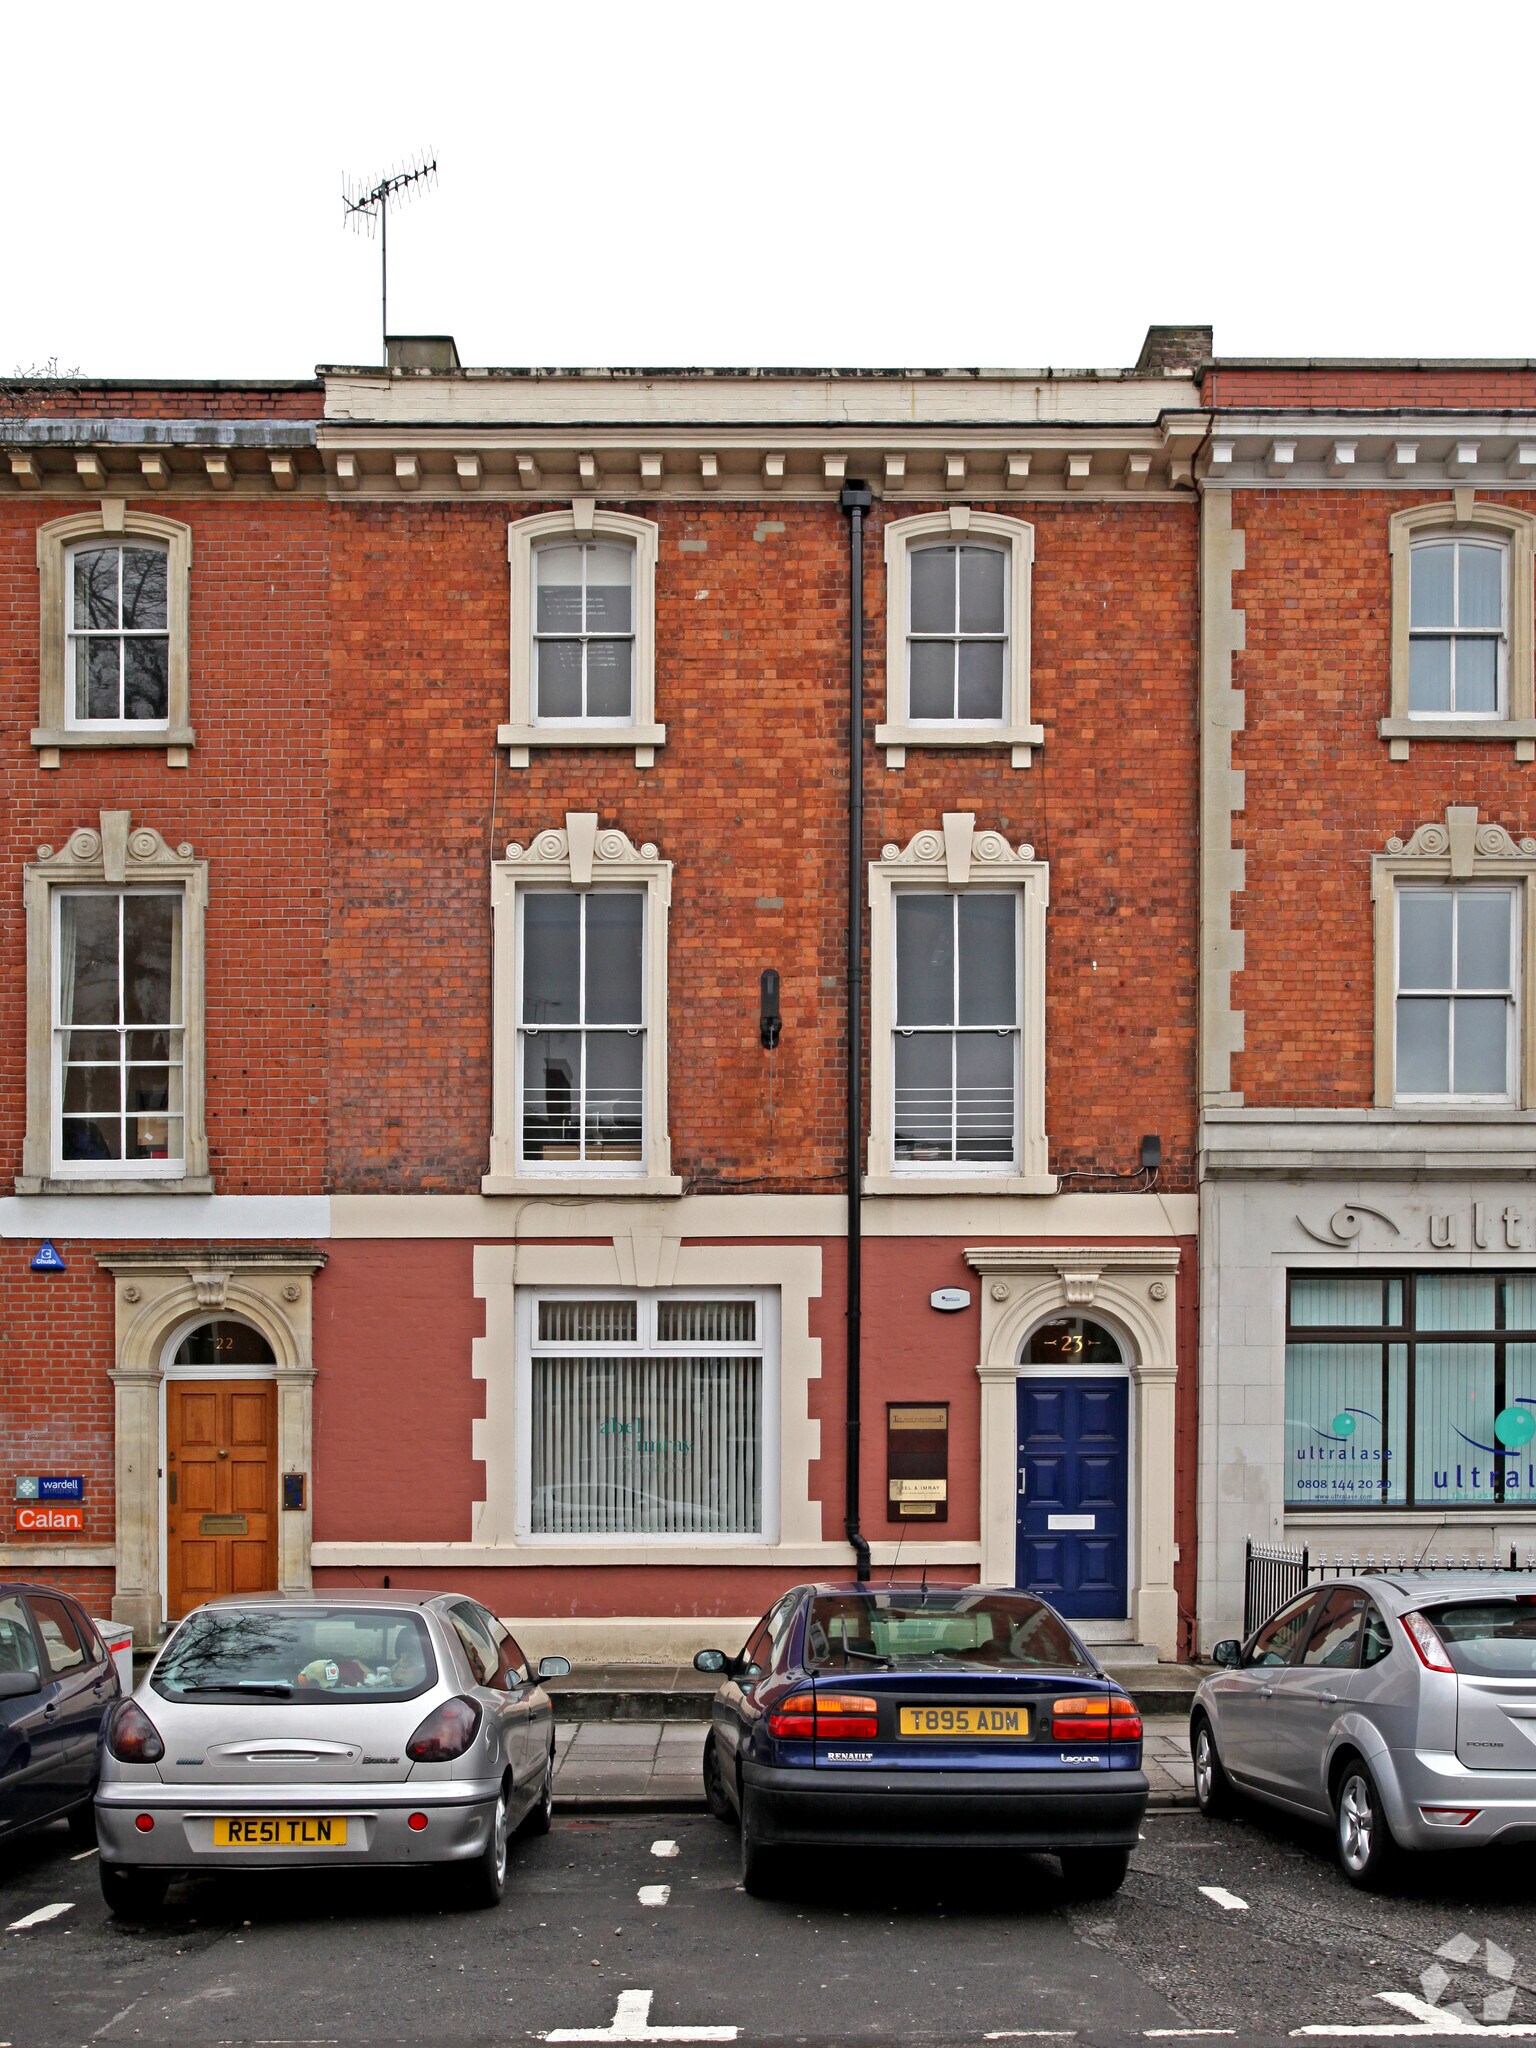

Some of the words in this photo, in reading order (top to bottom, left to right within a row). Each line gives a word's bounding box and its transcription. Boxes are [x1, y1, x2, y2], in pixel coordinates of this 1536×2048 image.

[216, 1337, 233, 1350] 22
[1061, 1335, 1083, 1353] 23
[600, 1417, 641, 1434] abel
[637, 1436, 692, 1457] imray
[1297, 1446, 1393, 1460] ultralase
[43, 1479, 78, 1489] wardell
[1434, 1464, 1535, 1488] ultral
[1297, 1479, 1328, 1489] 0808
[1331, 1479, 1354, 1491] 144
[1357, 1479, 1373, 1489] 20
[1376, 1479, 1392, 1489] 20
[19, 1510, 82, 1528] Calan.
[911, 1711, 969, 1730] T895
[977, 1711, 1019, 1731] ADM
[827, 1752, 873, 1762] RENAULT
[1060, 1753, 1100, 1765] Laguna
[287, 1821, 332, 1841] TLN
